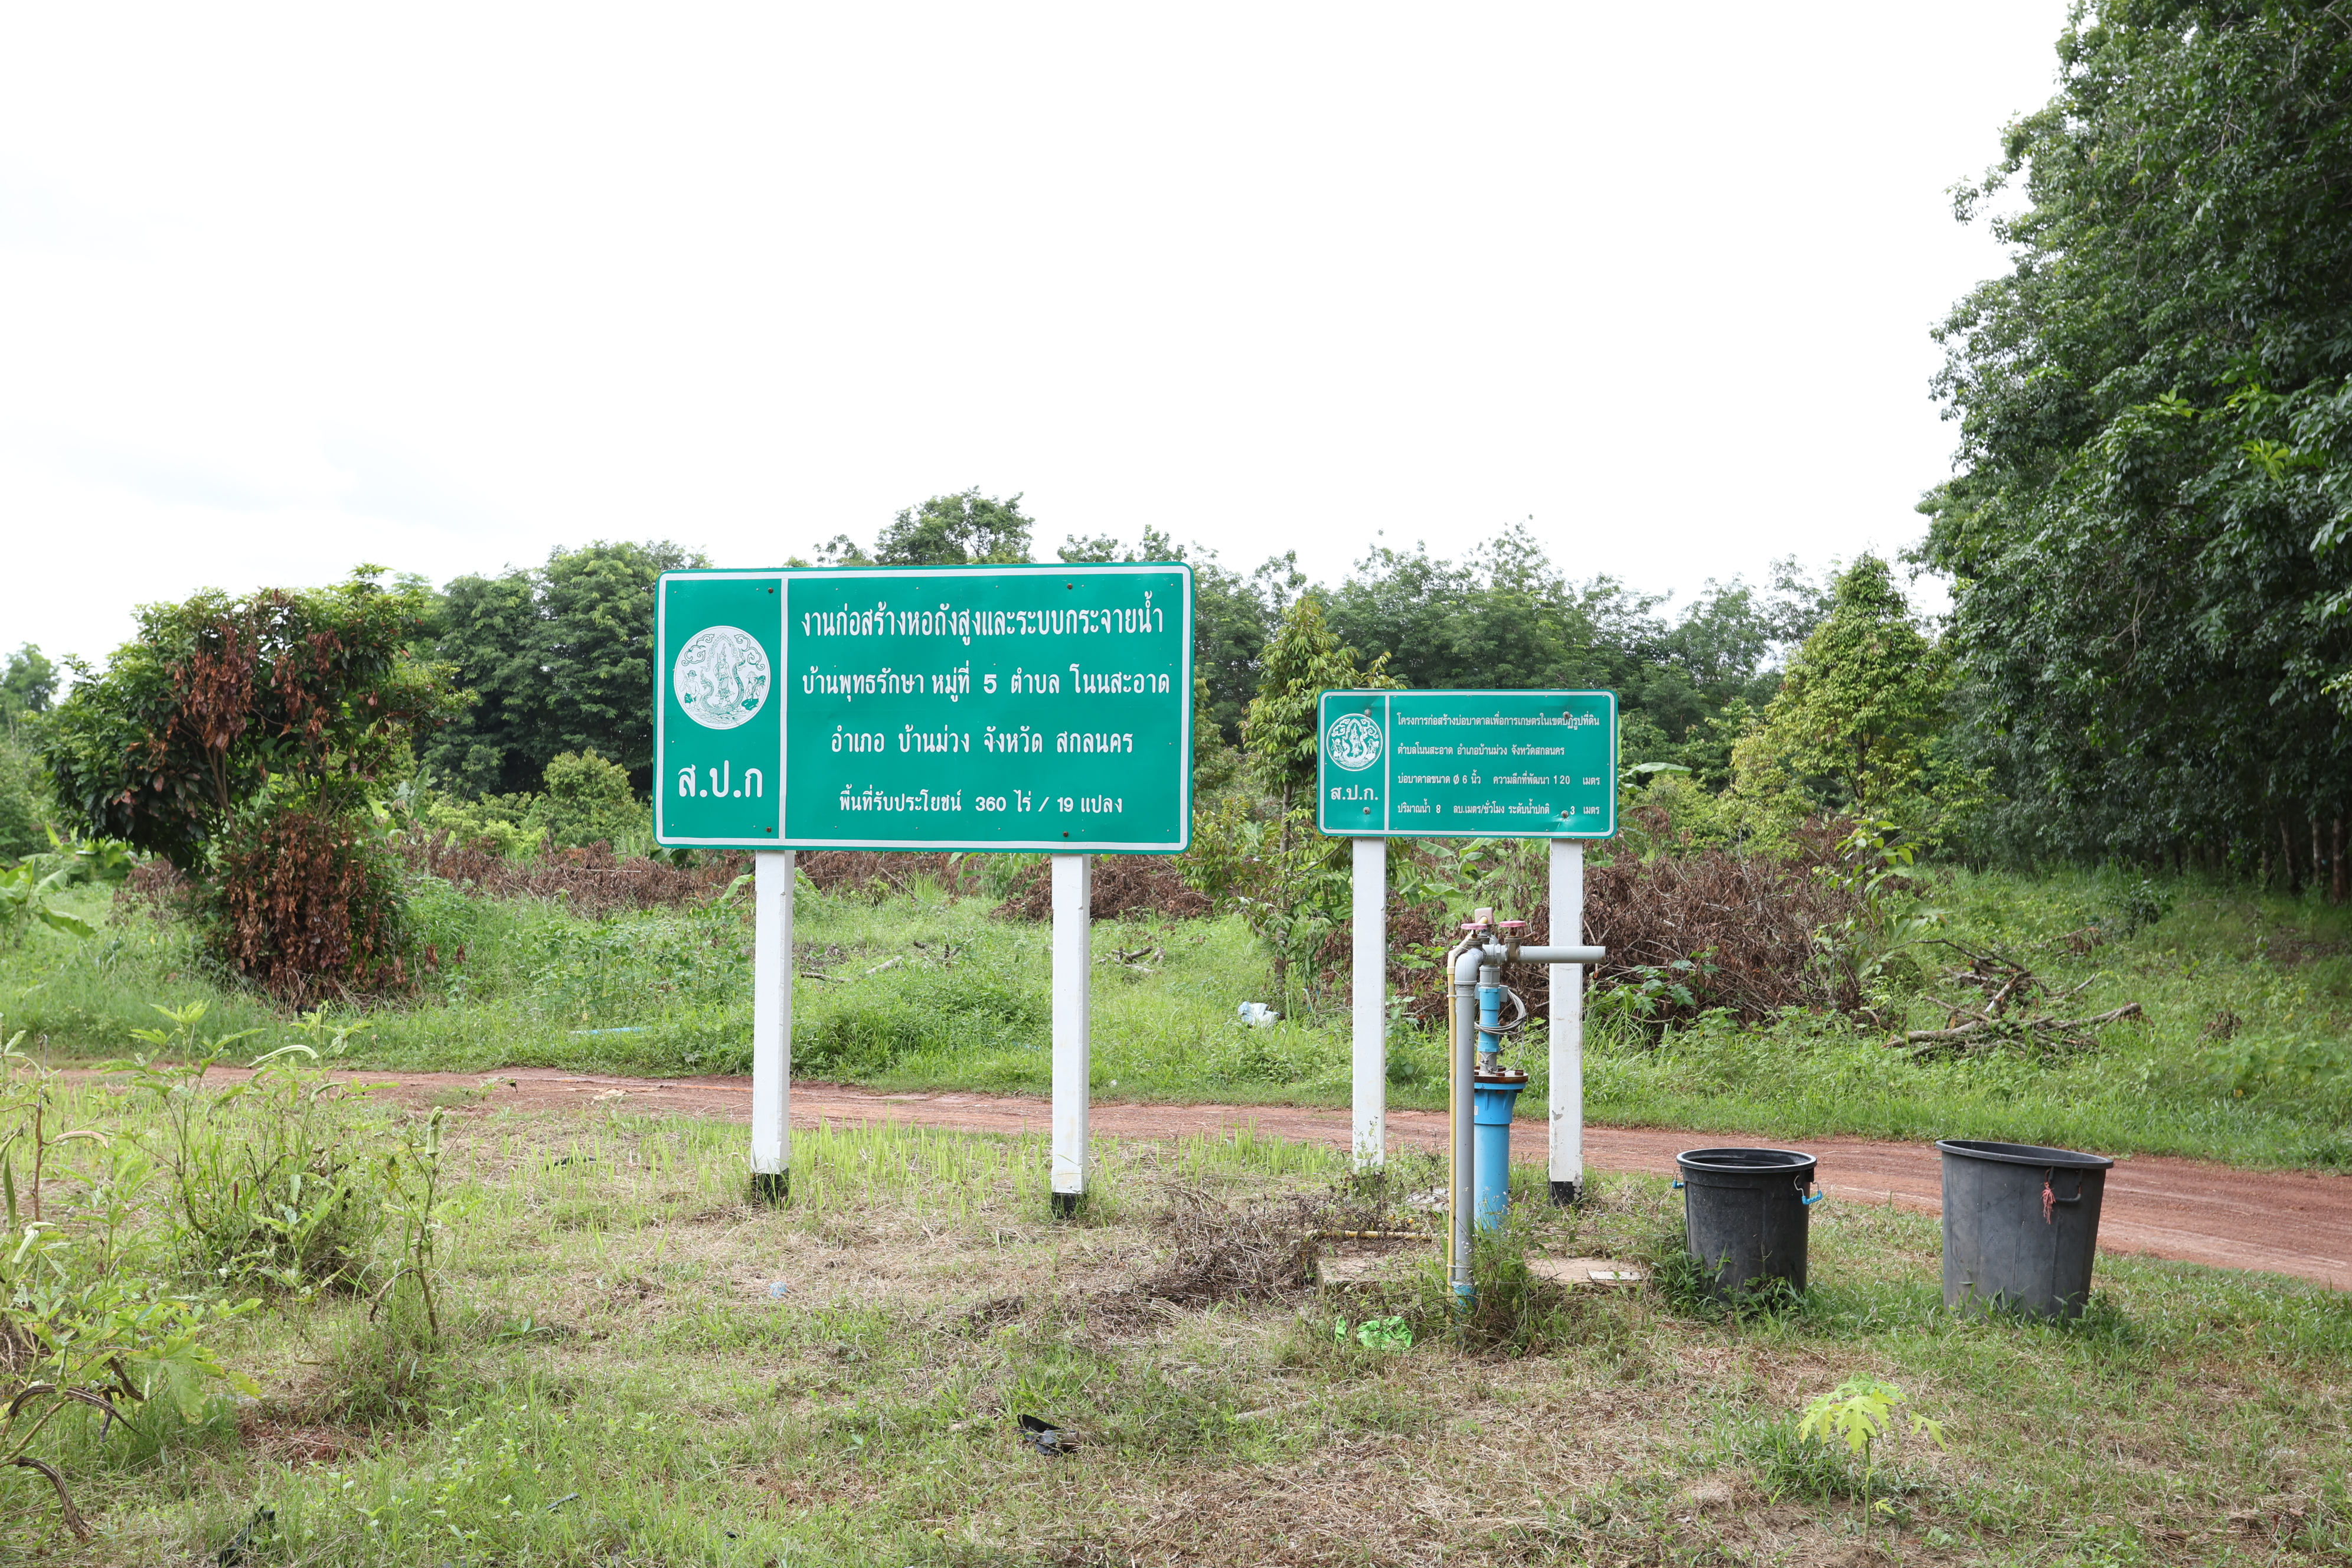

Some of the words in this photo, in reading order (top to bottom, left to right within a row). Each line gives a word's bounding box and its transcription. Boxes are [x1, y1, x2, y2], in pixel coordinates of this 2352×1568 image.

[801, 590, 1163, 646] งานก่อสร้างหอถังสูงและระบบกระจายน้ำ
[802, 665, 924, 703] บ้านพุทธรักษา
[932, 659, 970, 703] หมู่ที่
[983, 674, 997, 694] 5
[1011, 667, 1060, 694] ตำบล
[1069, 663, 1170, 694] โนนสะอาด
[831, 724, 885, 753] อำเภอ
[898, 724, 970, 753] บ้านม่วง
[984, 725, 1043, 753] จังหวัด
[1056, 730, 1133, 753] สกลนคร
[1397, 741, 1453, 755] ตำบลโนนสะอาด
[1457, 743, 1508, 755] อำเภอบ้านม่วง
[1511, 743, 1565, 756] จังหวัดสกลนคร
[678, 760, 763, 798] ส.ป.ก
[1397, 772, 1451, 784] บ่อบาดาลขนาด
[1462, 775, 1468, 784] 6
[1471, 769, 1481, 784] นิ้ว
[1493, 770, 1550, 785] ความลึกที่พัฒนา
[1583, 777, 1600, 785] เมตร
[839, 783, 962, 812] พื้นที่รับประโยชน์
[975, 796, 1007, 812] 360
[1012, 789, 1031, 812] ไร่
[1057, 796, 1074, 812] 19
[1081, 794, 1122, 814] แปลง
[1330, 784, 1378, 801] ส.ป.ก.
[1397, 798, 1430, 814] ปริมาณน้ำ
[1436, 804, 1441, 814] 8
[1508, 798, 1550, 815] ระดับน้ำปกติ
[1570, 805, 1575, 815] 3
[1583, 806, 1600, 815] เมตร
